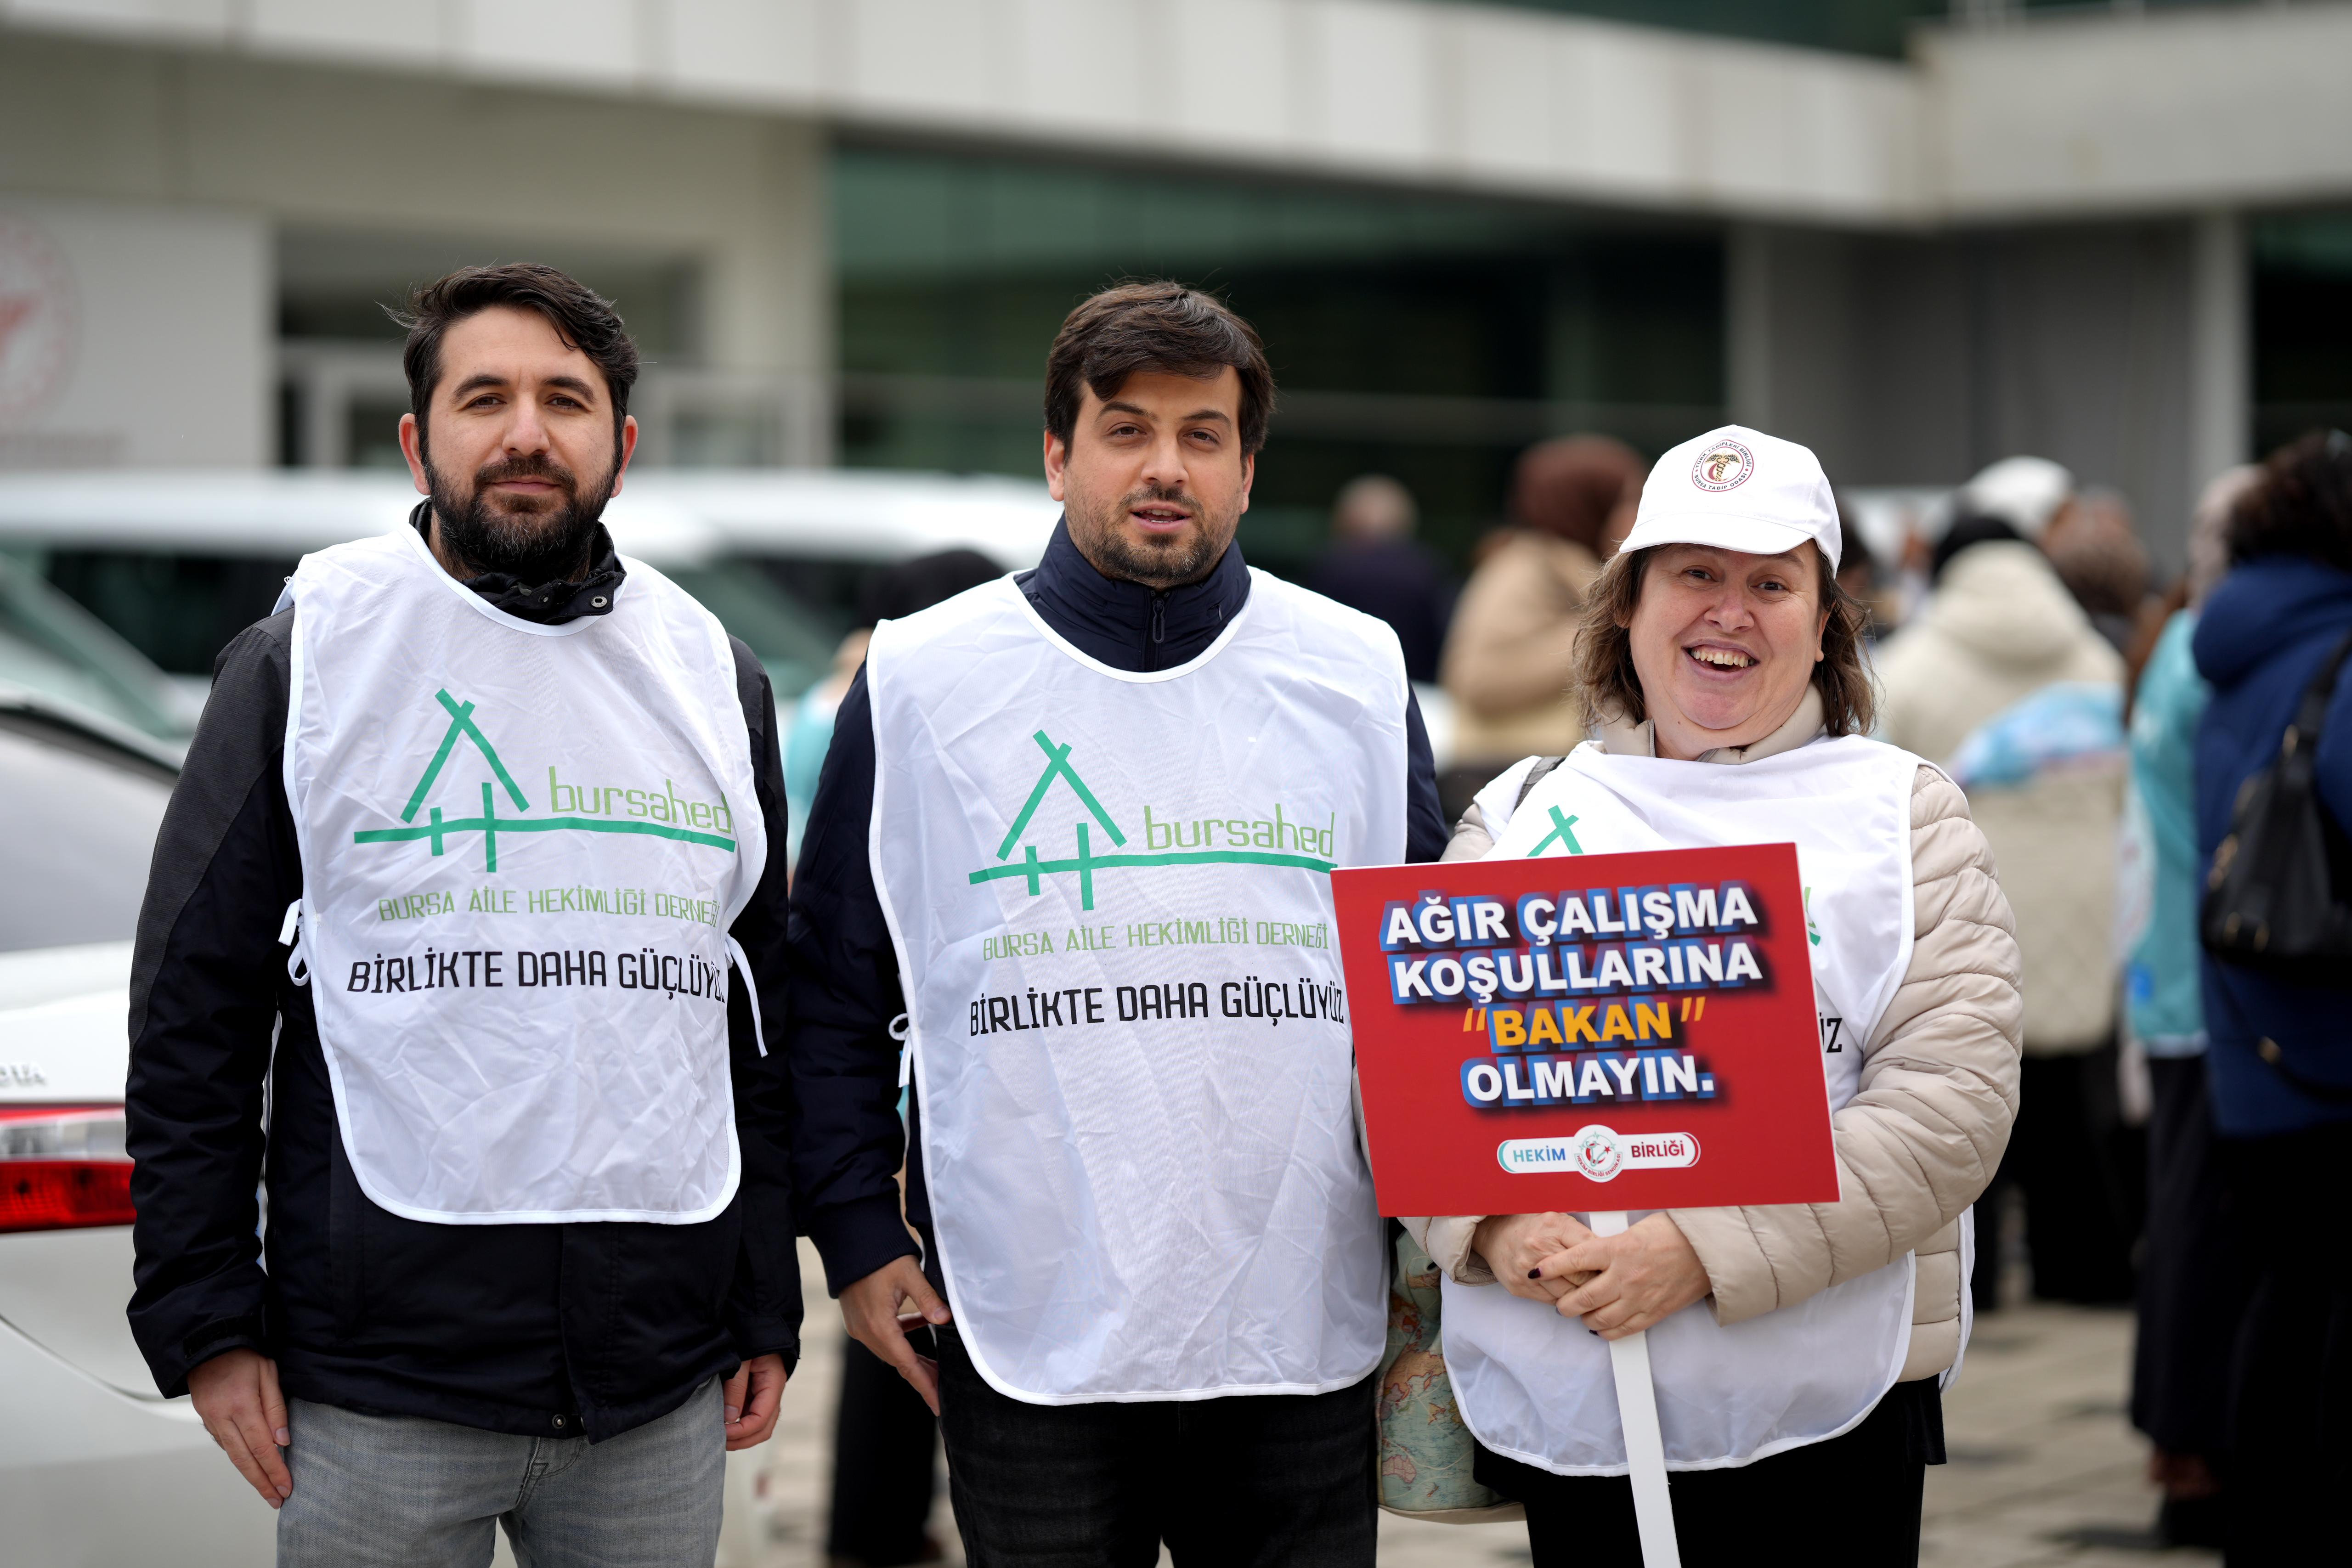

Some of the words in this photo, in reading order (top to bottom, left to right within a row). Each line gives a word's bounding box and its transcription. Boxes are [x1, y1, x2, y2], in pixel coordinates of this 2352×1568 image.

[1696, 453, 1707, 468] TÜRK
[1708, 442, 1739, 452] TABİPLERİ
[1740, 448, 1752, 467] BİRLİĞİ
[1695, 474, 1706, 488] BURSA
[1730, 473, 1747, 487] ODASI
[549, 766, 732, 835] bursahed
[1143, 803, 1335, 857] bursahed
[378, 891, 455, 921] BURSA
[469, 886, 517, 914] AİLE
[528, 884, 646, 916] HEKİMLİĞİ
[1385, 896, 1511, 945] AĞIR
[1523, 886, 1758, 947] ÇALIŞMA
[983, 932, 1055, 961] BURSA
[1065, 924, 1117, 951] AİLE
[1127, 917, 1249, 948] HEKİMLİĞİ
[1256, 922, 1329, 950] DERNEĞİ
[347, 947, 503, 993] BİRLİKTE
[518, 950, 607, 987] DAHA
[1392, 942, 1763, 1004] KOŞULLARINA
[971, 987, 1105, 1037] BİRLİKTE
[1117, 982, 1209, 1022] DAHA
[1221, 976, 1345, 1027] GÜÇLÜYÜZ
[1467, 1055, 1714, 1102] OLMAYIN.
[1513, 1145, 1566, 1162] HEKİM
[1630, 1139, 1685, 1158] BİRLİĞİ
[1577, 1155, 1588, 1171] HEKİM
[1606, 1154, 1621, 1176] SENDİKASI
